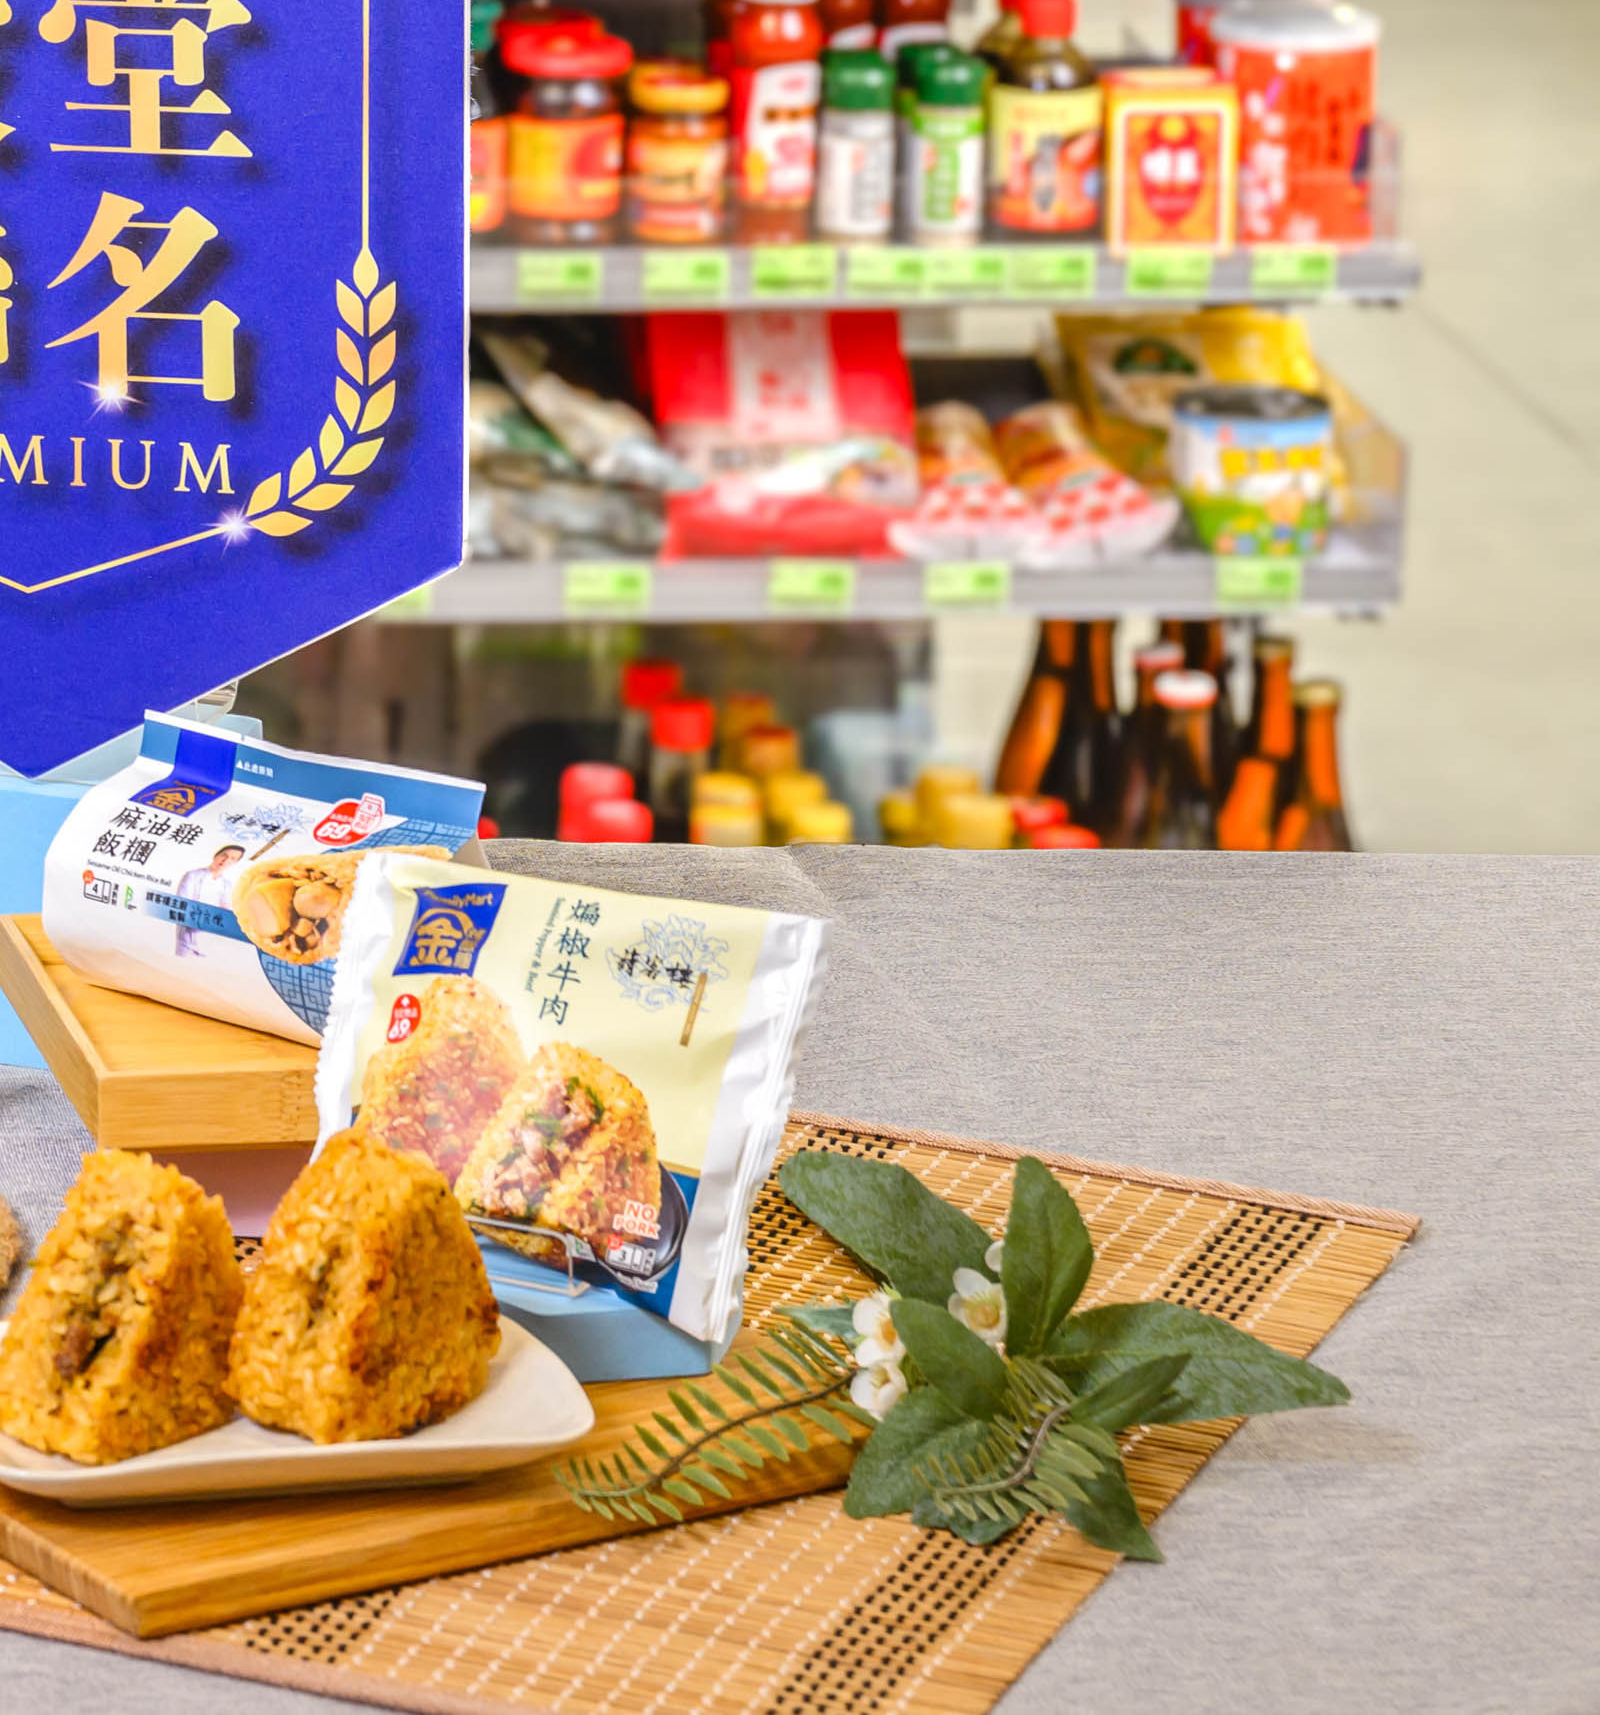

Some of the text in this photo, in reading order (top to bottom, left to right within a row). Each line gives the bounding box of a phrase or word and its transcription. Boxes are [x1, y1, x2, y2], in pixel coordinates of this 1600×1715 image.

[109, 805, 204, 846] 麻油雞
[538, 898, 601, 1026] 煸椒牛肉
[627, 1203, 655, 1221] NO
